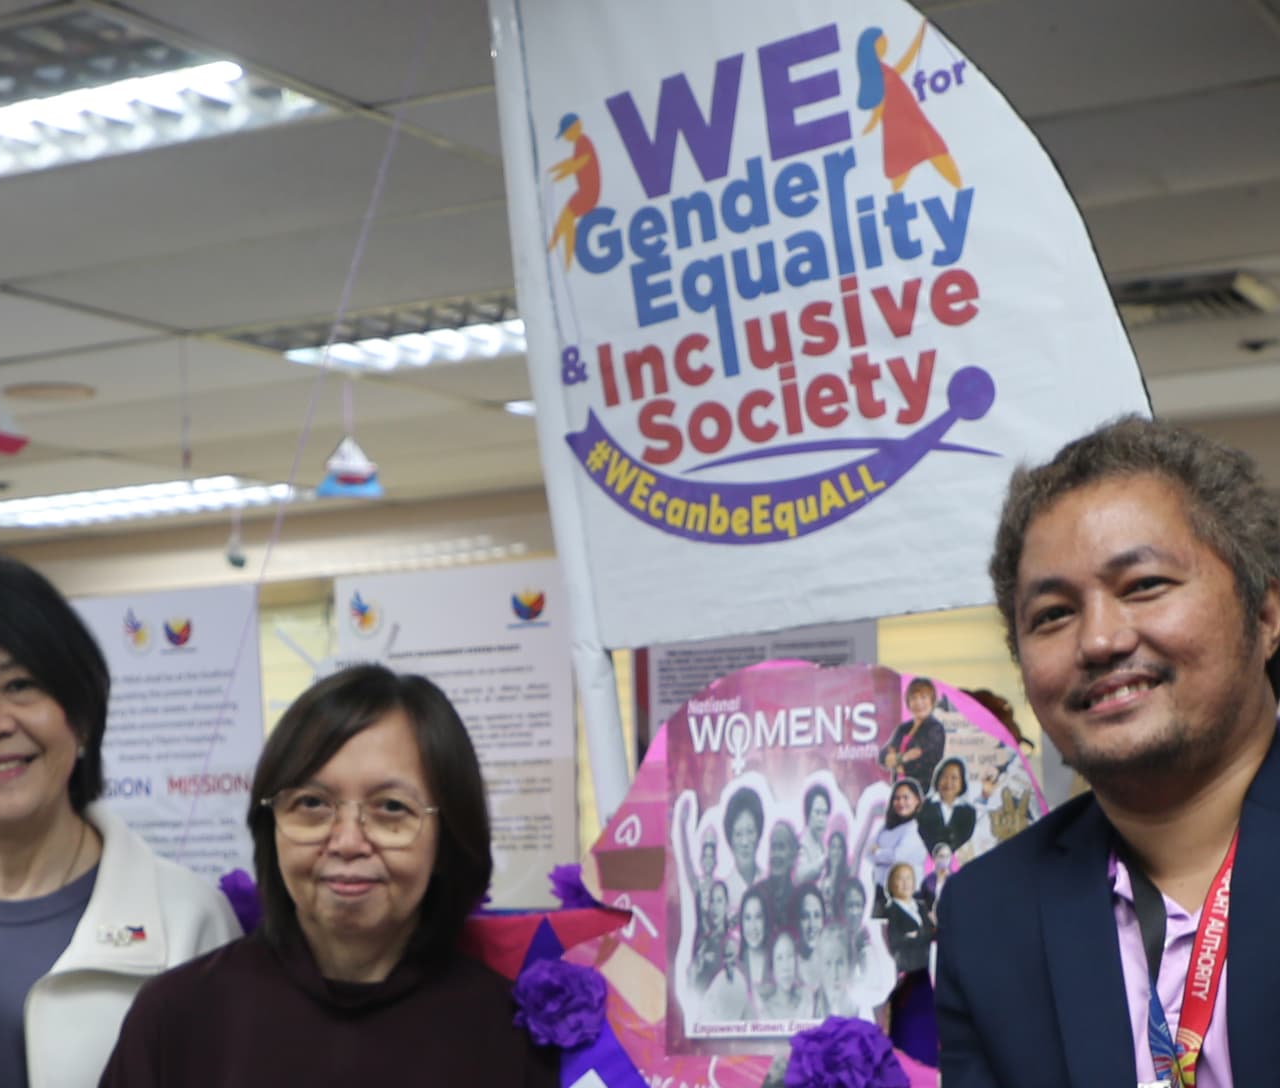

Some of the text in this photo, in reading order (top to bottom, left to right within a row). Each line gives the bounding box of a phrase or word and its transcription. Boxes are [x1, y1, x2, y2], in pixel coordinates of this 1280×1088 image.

[605, 23, 967, 199] WE for
[575, 146, 858, 275] Gender
[561, 269, 980, 407] & Inclusive
[631, 188, 975, 378] Equality
[637, 349, 937, 465] Society
[586, 440, 886, 538] #WEcanbeEquALL
[688, 703, 879, 757] WOMEN'S
[1191, 915, 1226, 1002] AUTHORITY
